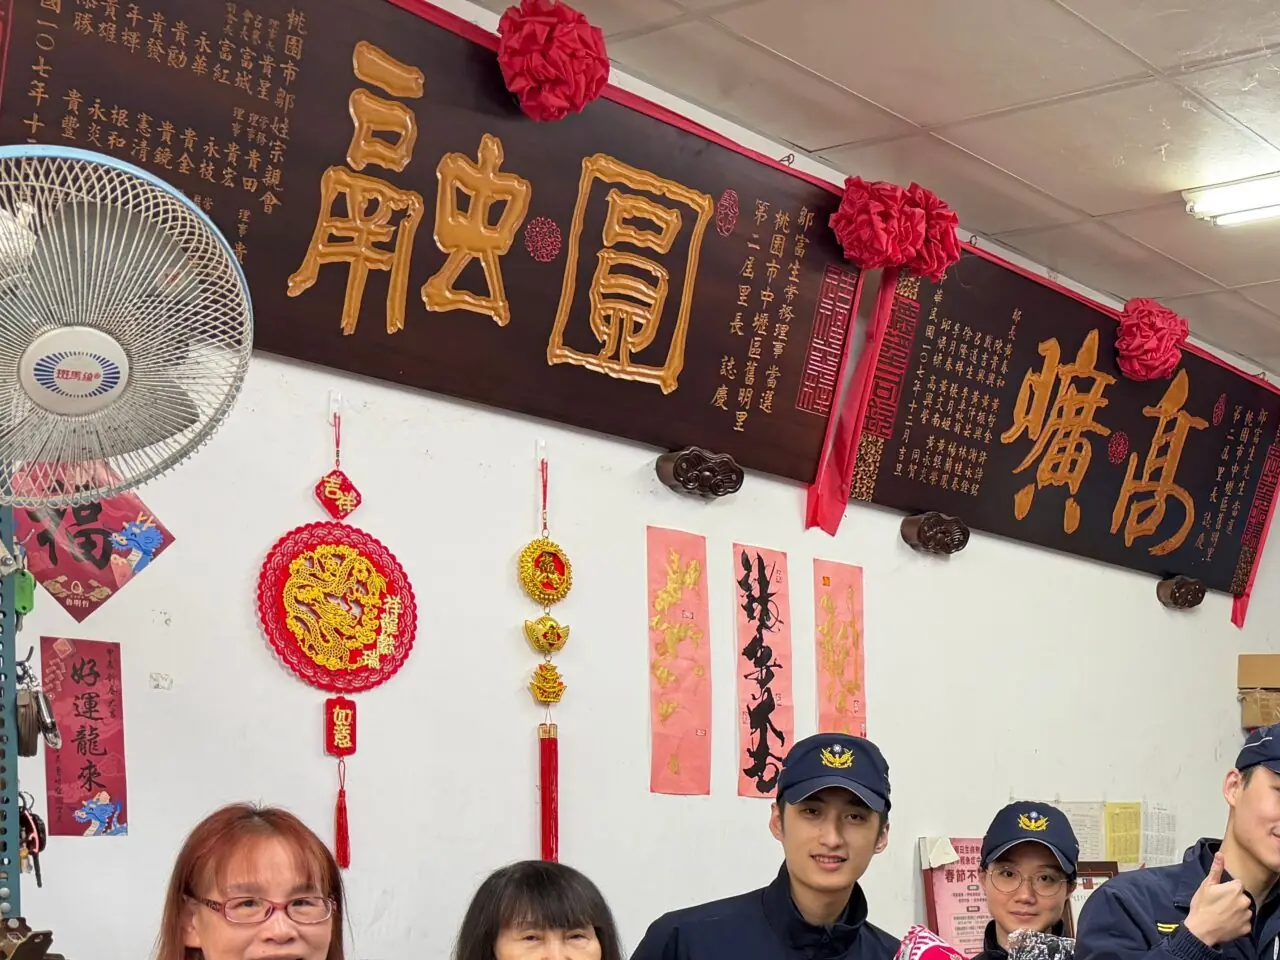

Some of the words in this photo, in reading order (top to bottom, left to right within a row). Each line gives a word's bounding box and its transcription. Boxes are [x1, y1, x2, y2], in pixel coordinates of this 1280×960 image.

[324, 475, 356, 512] 吉祥
[71, 657, 107, 792] 好運龍來
[945, 869, 982, 883] 春節不
